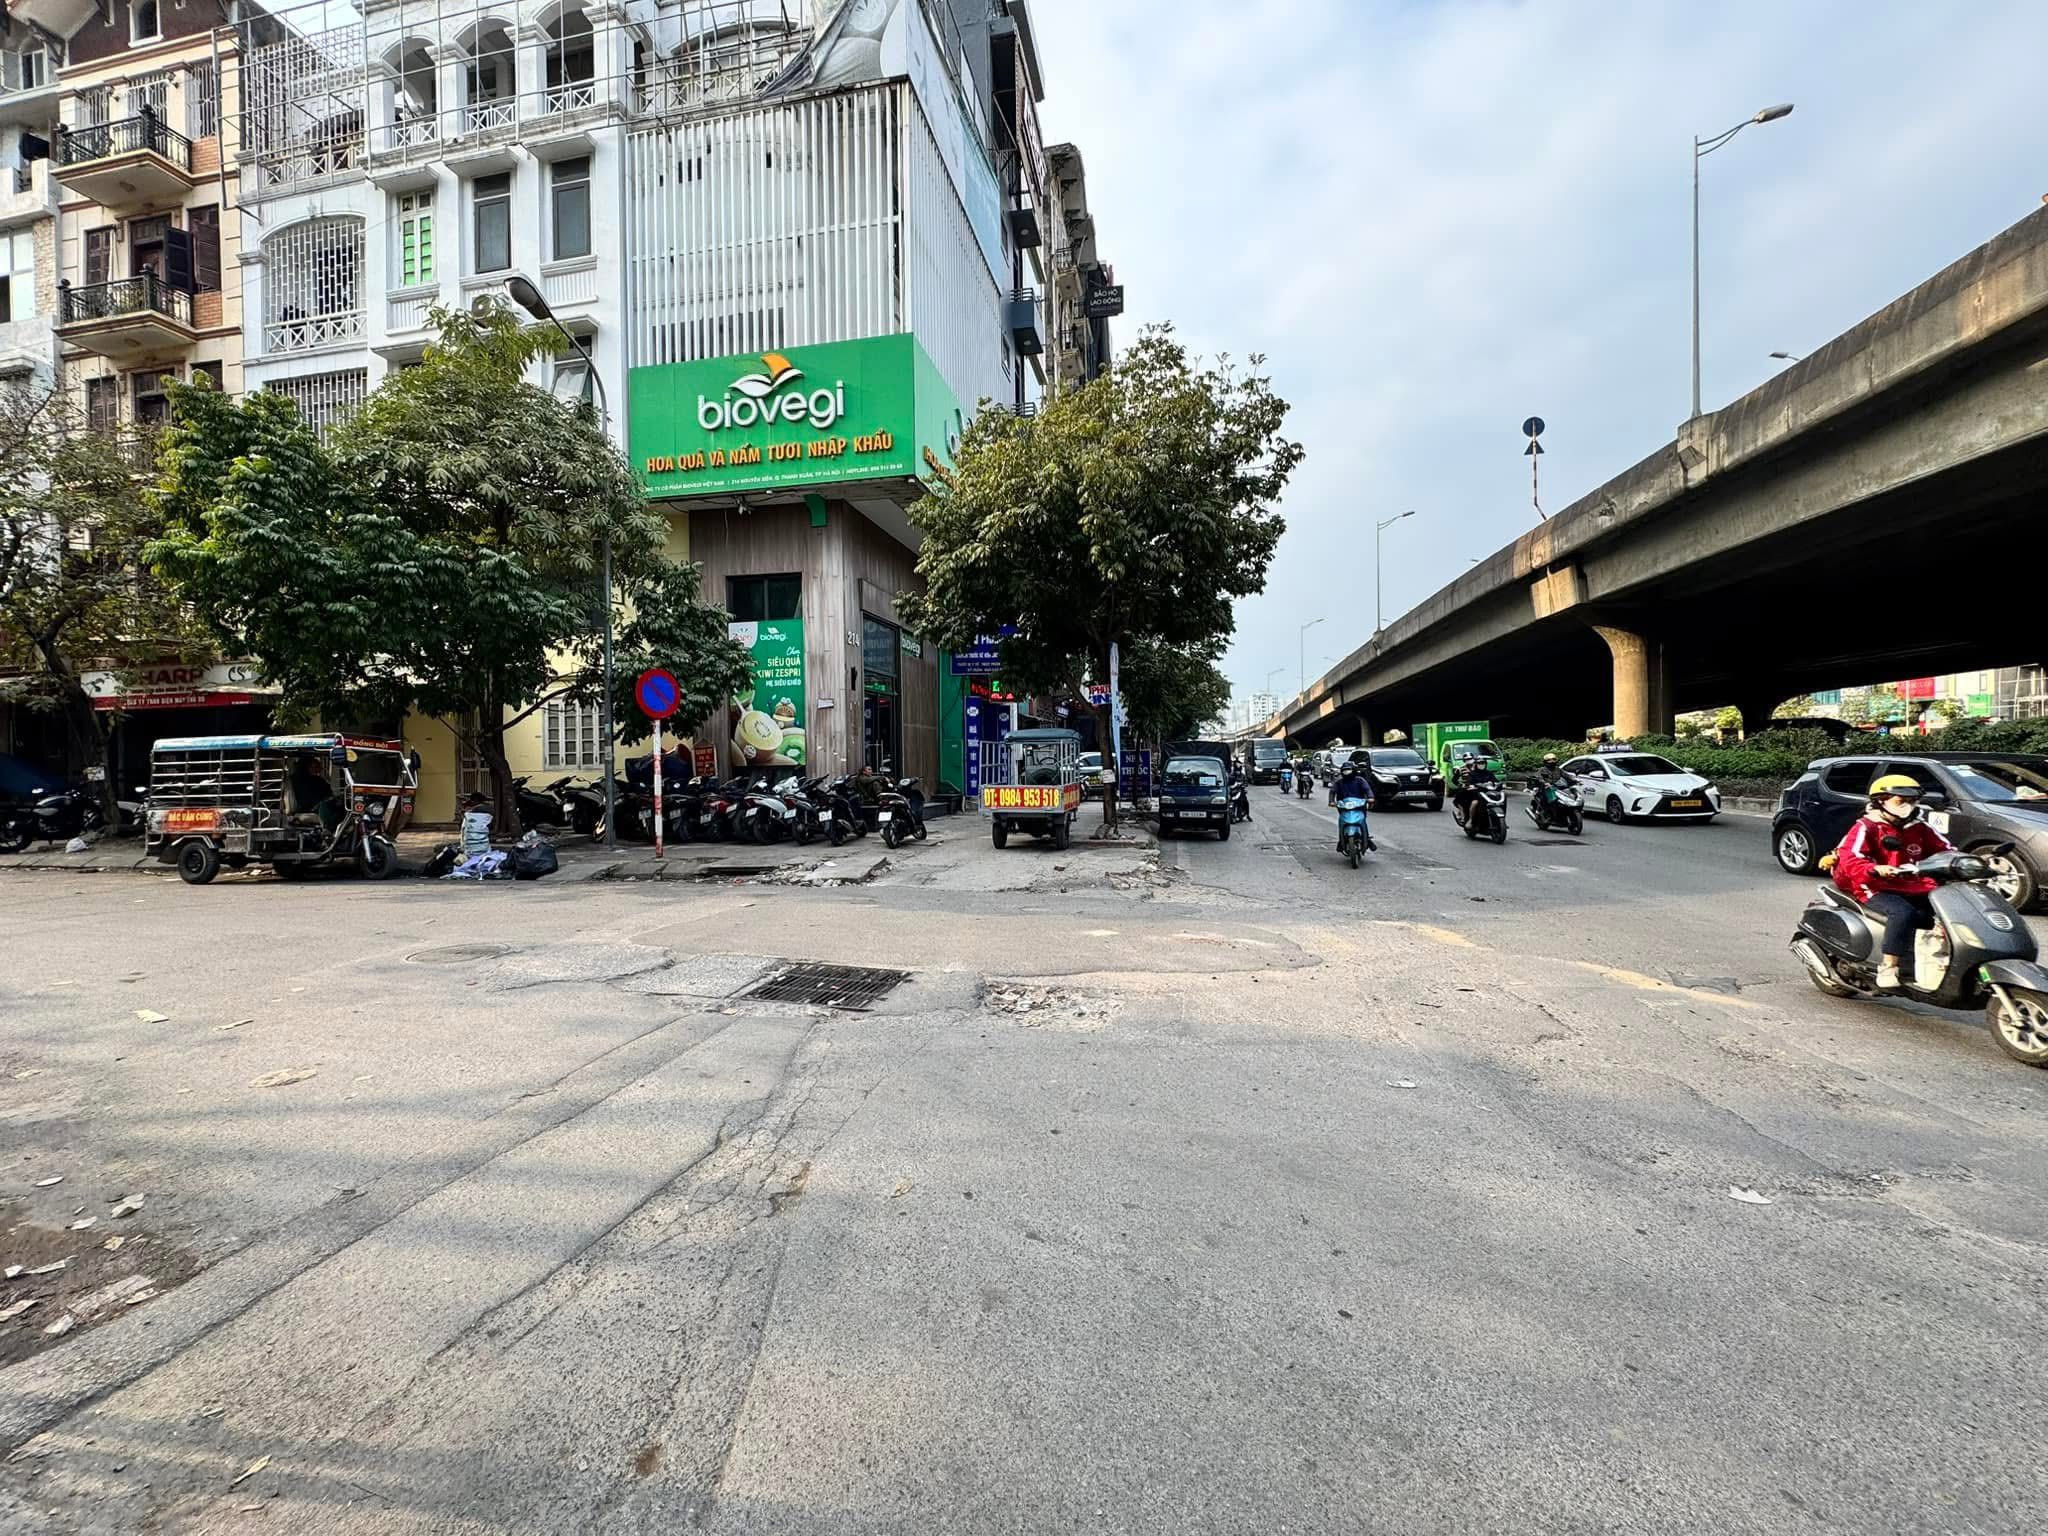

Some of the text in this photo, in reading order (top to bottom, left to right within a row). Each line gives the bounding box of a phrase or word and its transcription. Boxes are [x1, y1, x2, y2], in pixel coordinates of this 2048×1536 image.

[697, 380, 844, 430] biovegi
[647, 427, 893, 473] HOA QUẢ VÀ NẤM TƯƠI NHẬP KHẨU
[774, 667, 801, 678] ZESPRI
[1000, 788, 1021, 807] 0984
[1023, 788, 1041, 807] 953
[1042, 788, 1060, 807] 518
